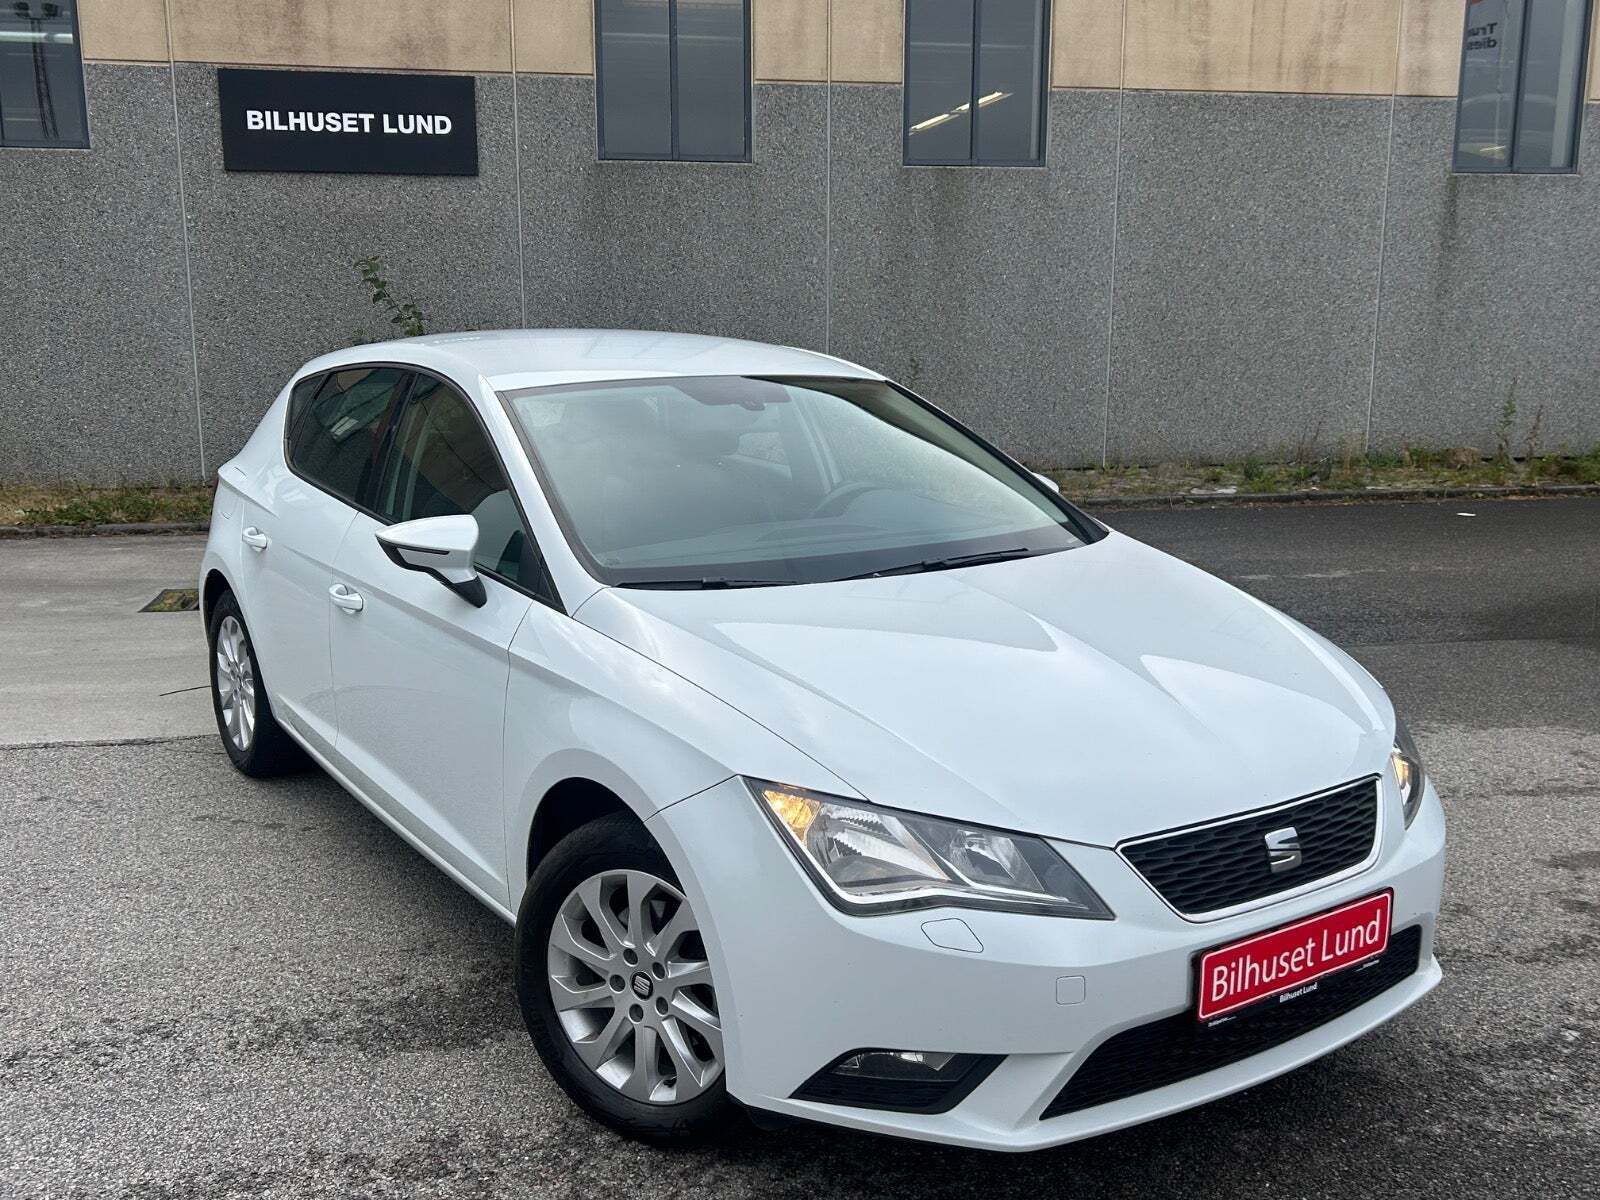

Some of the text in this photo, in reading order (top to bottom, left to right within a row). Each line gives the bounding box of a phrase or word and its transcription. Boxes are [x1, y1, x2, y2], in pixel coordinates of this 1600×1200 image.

[246, 109, 452, 135] BILHUSET LUND
[1211, 908, 1381, 1002] Bilhuset Lund
[1279, 982, 1318, 1003] Bilhuset Lund
